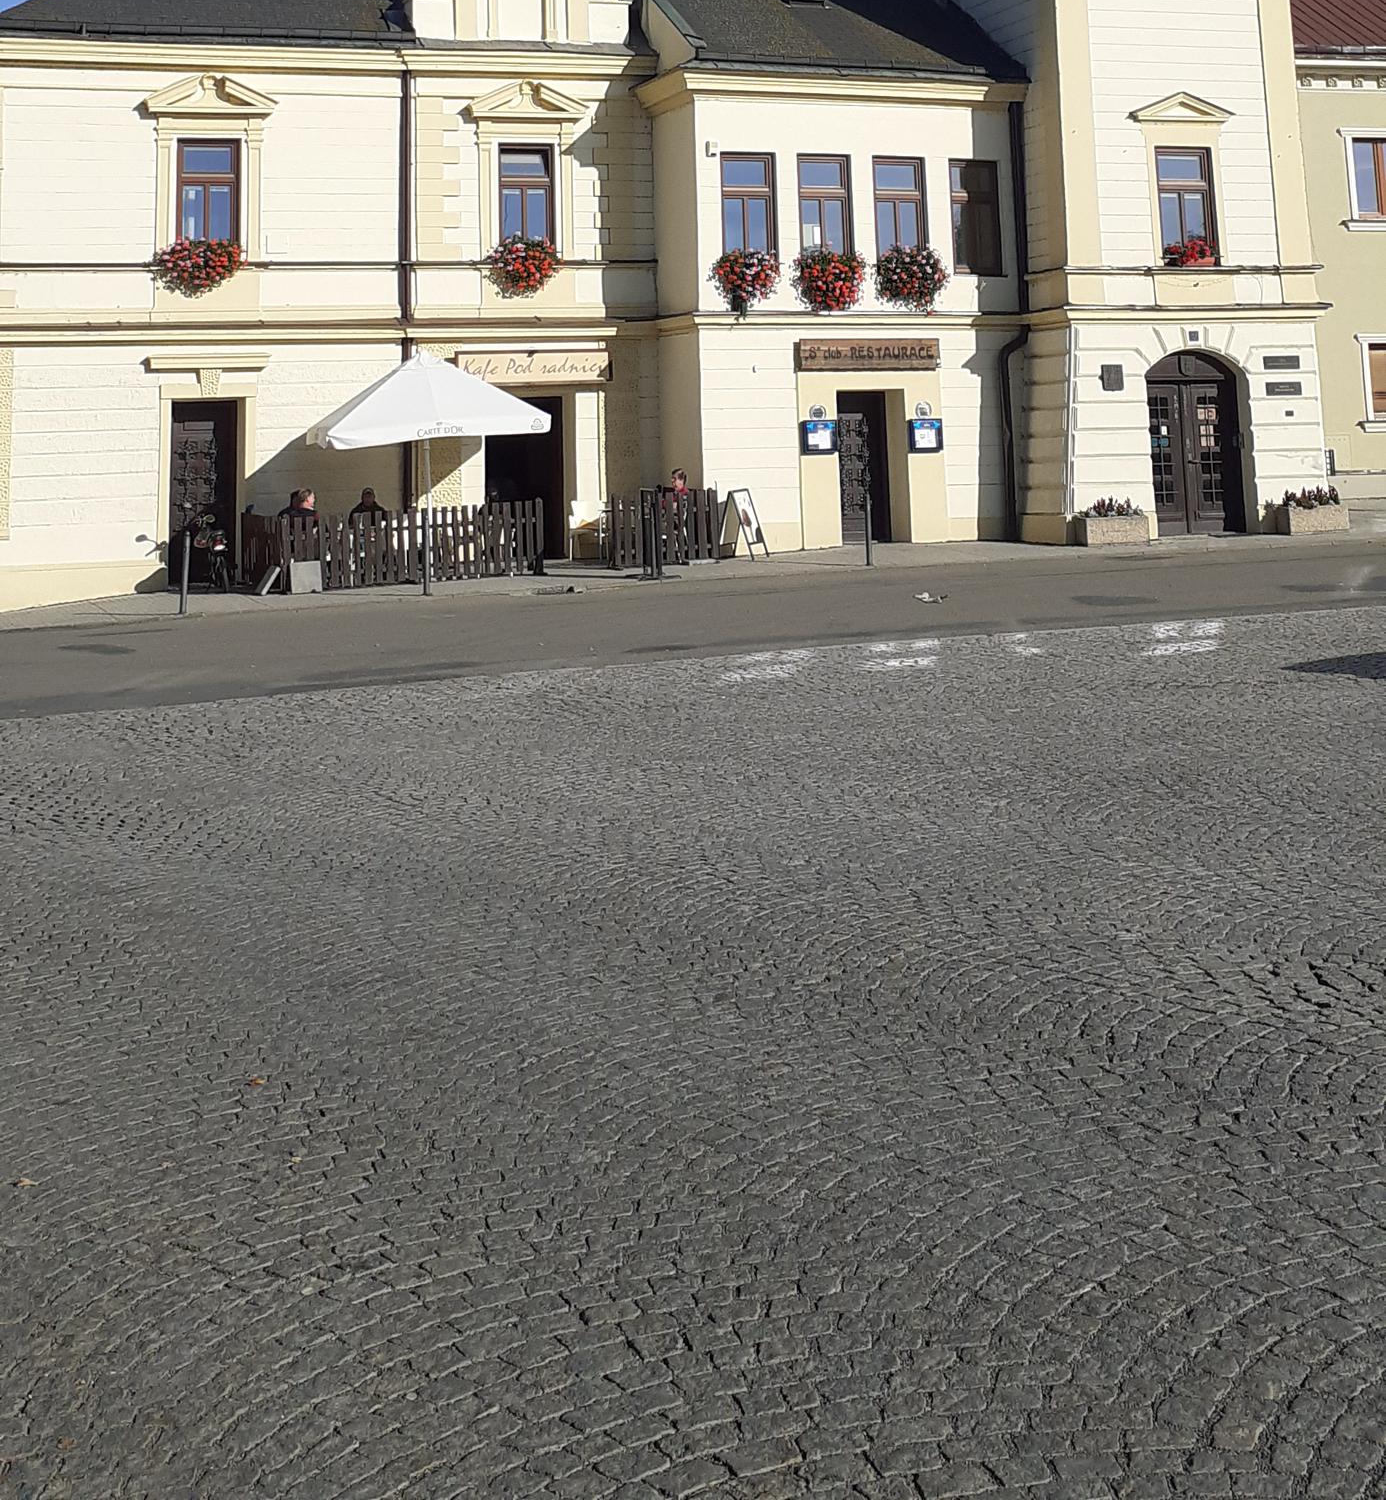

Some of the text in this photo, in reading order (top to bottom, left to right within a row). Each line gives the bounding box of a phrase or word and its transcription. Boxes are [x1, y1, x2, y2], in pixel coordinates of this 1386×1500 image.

[850, 346, 934, 360] RESTAURACE
[463, 358, 498, 381] Kafe
[505, 357, 534, 375] Pod
[417, 427, 441, 438] CARTE
